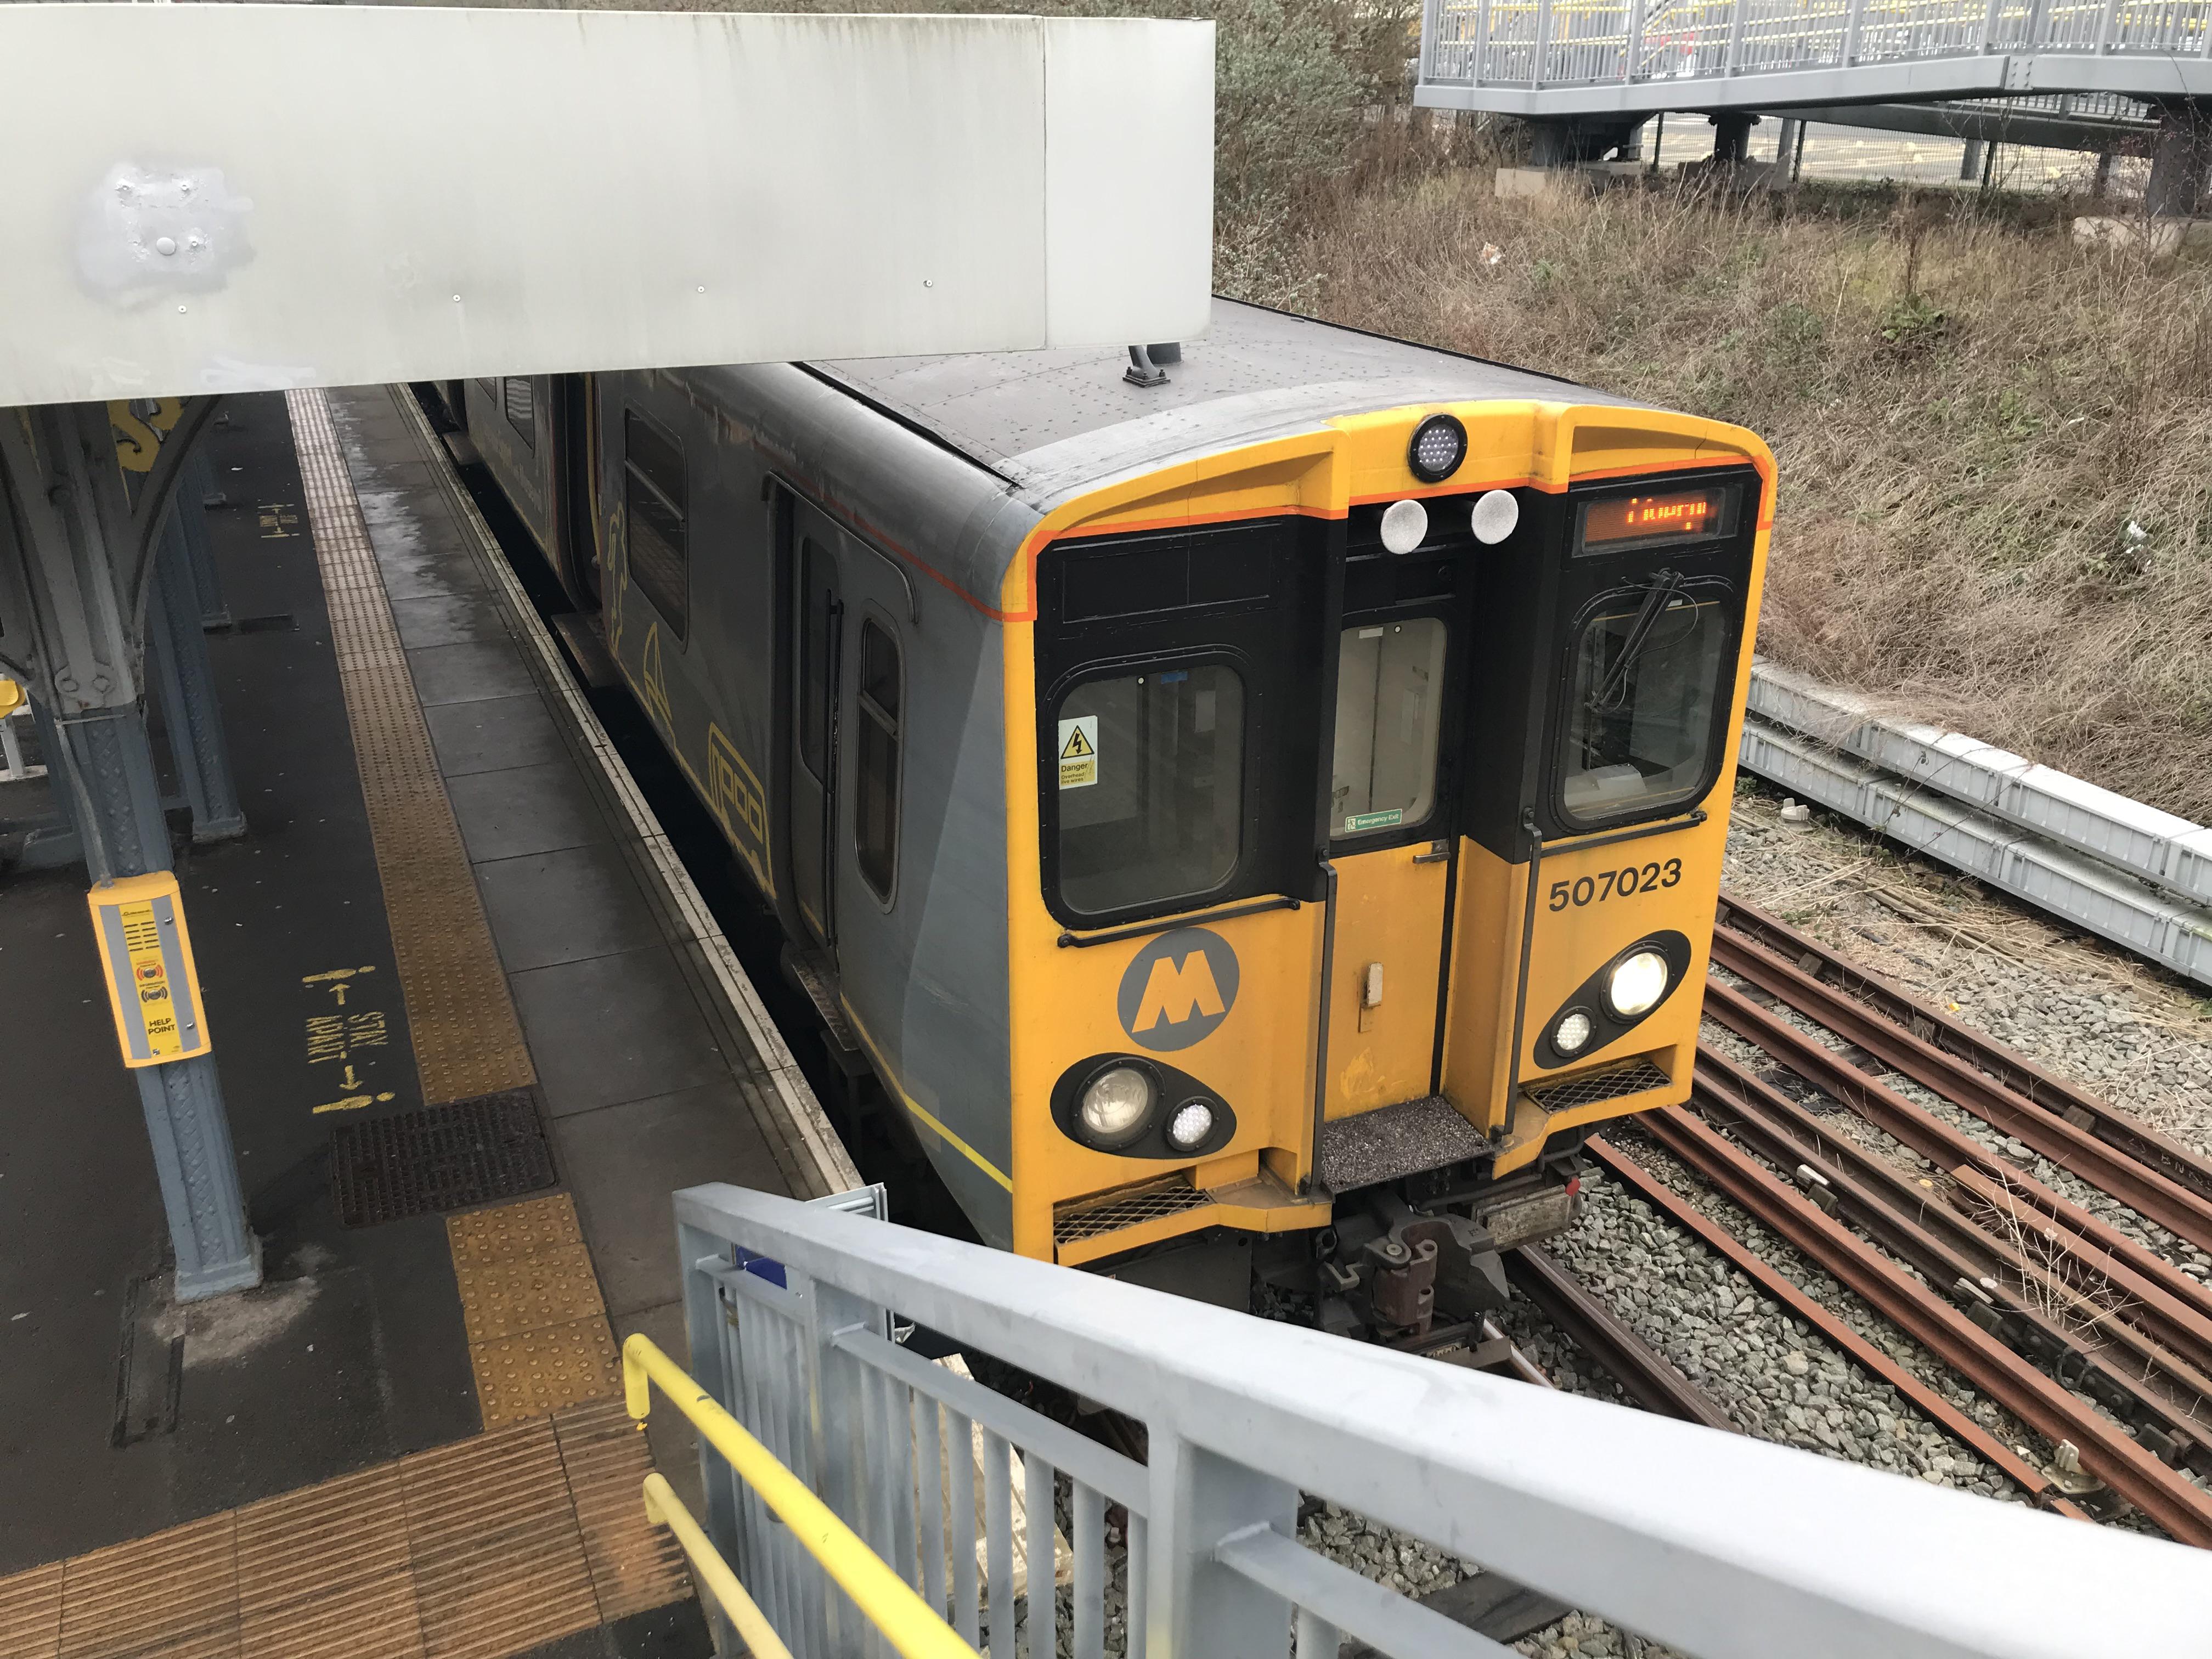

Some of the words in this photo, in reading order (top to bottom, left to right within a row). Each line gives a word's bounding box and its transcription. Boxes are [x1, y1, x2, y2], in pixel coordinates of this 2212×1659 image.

[1061, 763, 1088, 772] Danger
[1357, 816, 1387, 825] Emergency
[1548, 857, 1683, 912] 507023
[149, 1018, 171, 1027] HELP
[148, 1024, 176, 1035] POINT
